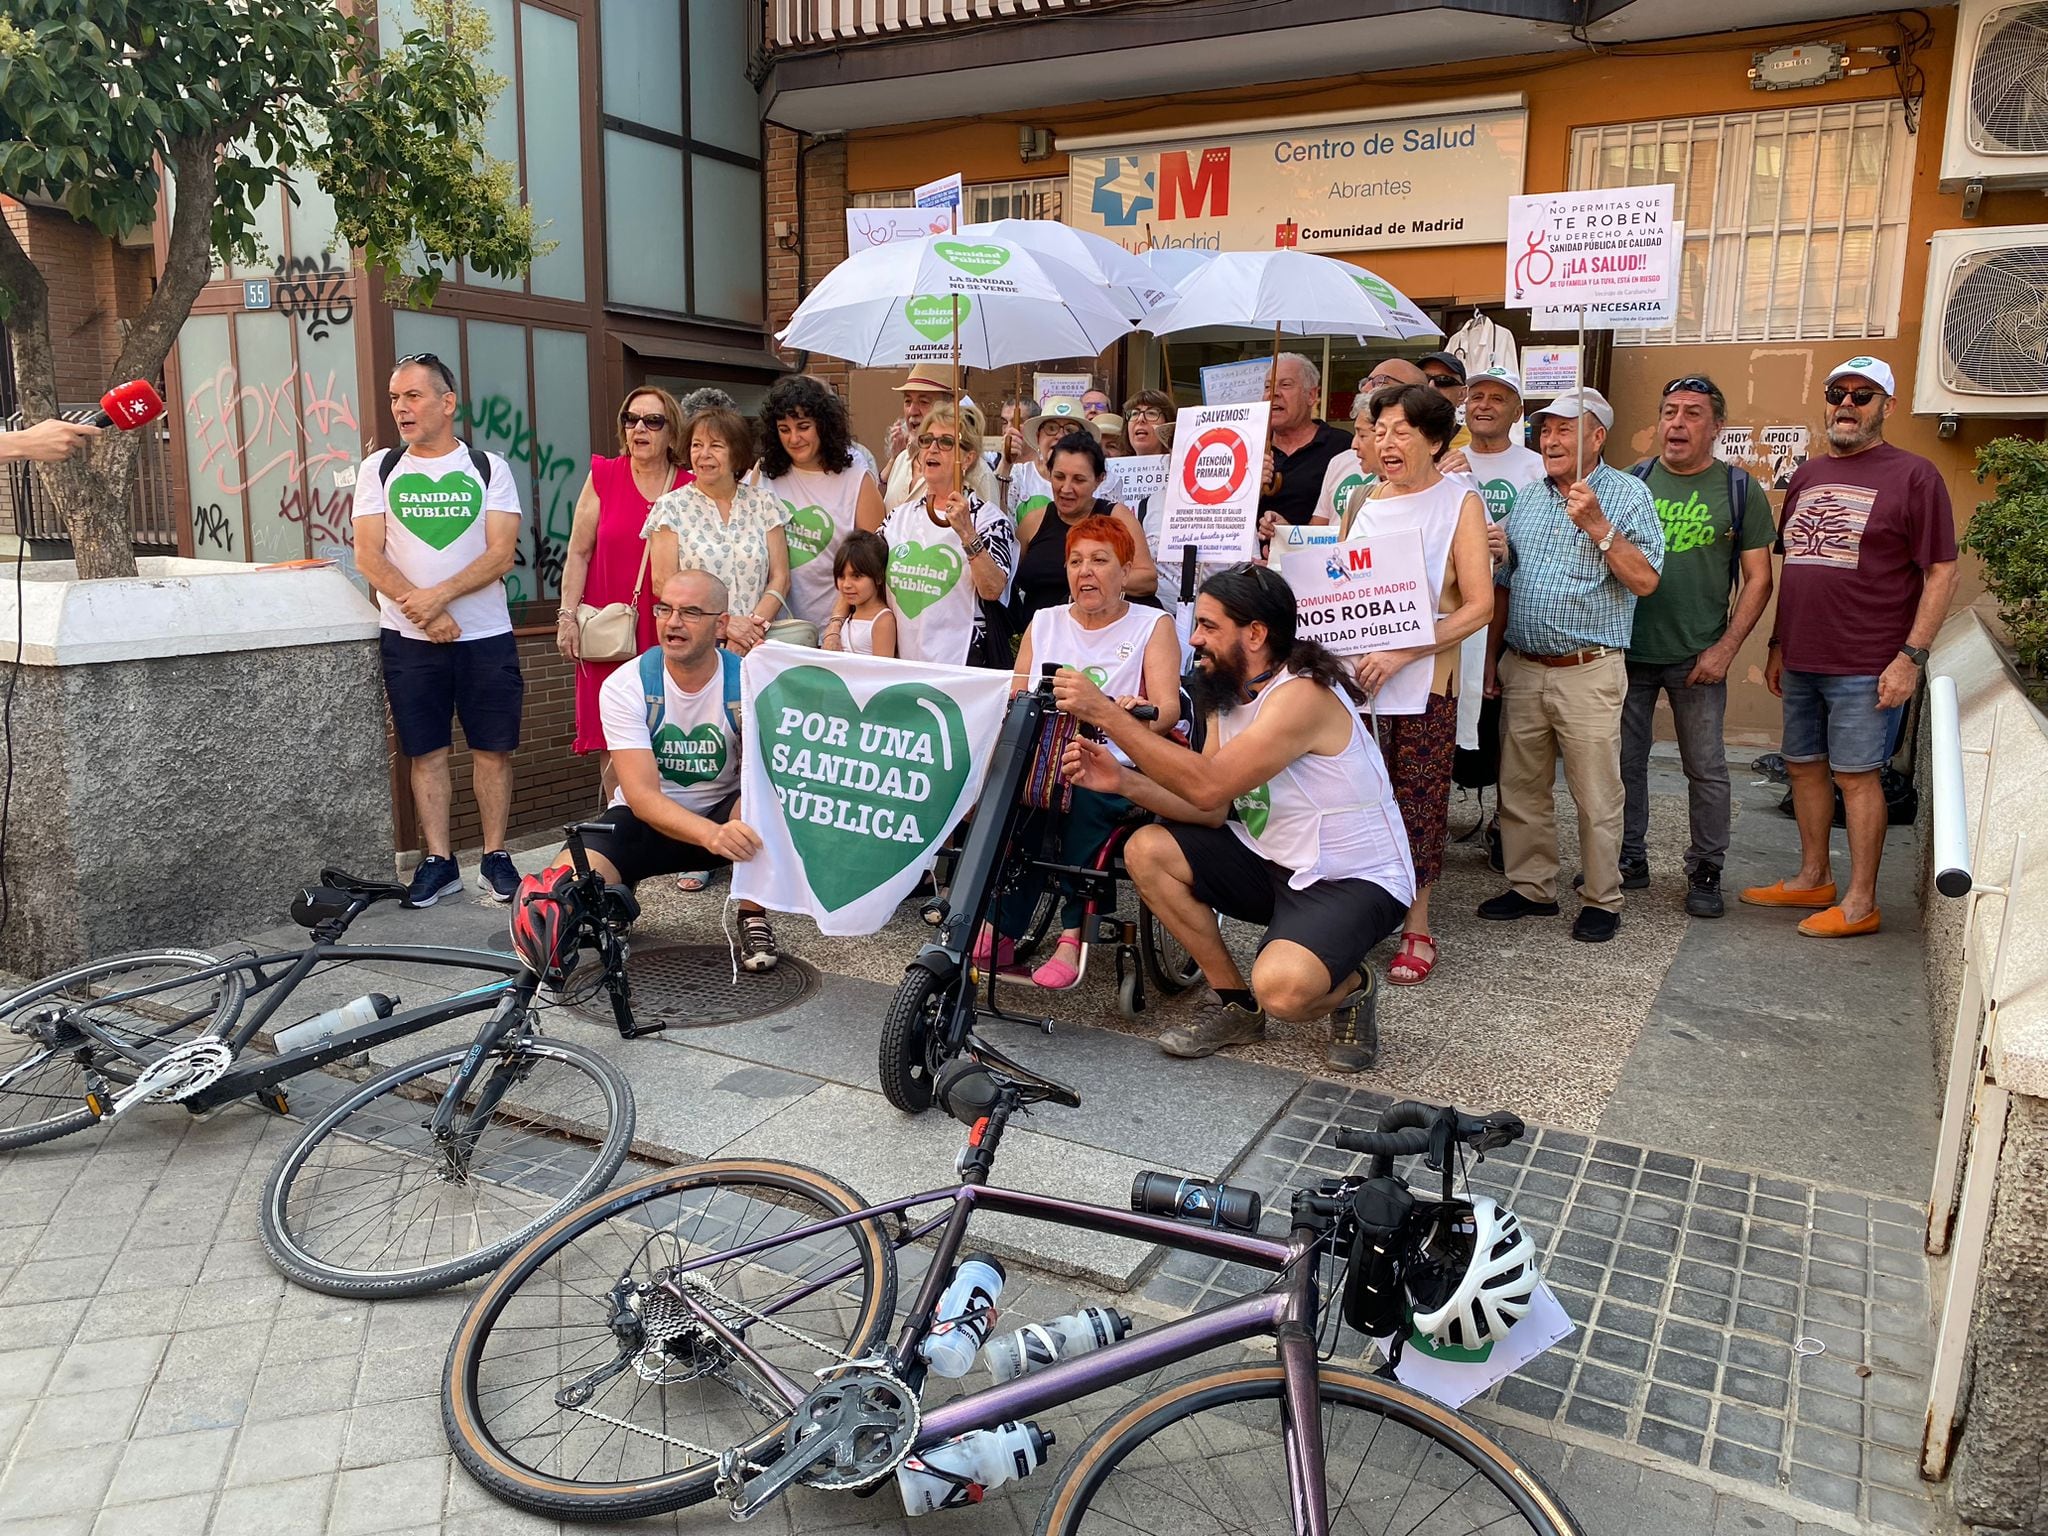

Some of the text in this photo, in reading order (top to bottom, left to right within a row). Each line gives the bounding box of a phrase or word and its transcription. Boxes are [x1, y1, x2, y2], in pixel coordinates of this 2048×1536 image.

[1275, 124, 1475, 164] Centro de Salud
[1158, 147, 1230, 220] M
[1328, 179, 1411, 199] Abrantes
[1550, 199, 1660, 214] NO PERMITAS QUE
[1301, 217, 1464, 240] Comunidad de Madrid
[1554, 212, 1657, 230] TE ROBEN
[1566, 230, 1621, 241] DERECHO
[1626, 229, 1634, 237] A
[1639, 227, 1664, 235] UNA
[1550, 237, 1662, 253] SANIDAD PÚBLICA DE CALIDAD
[945, 249, 1001, 259] Sanidad
[1591, 254, 1647, 273] SALUD!!
[965, 277, 1013, 286] SANIDAD
[982, 285, 1019, 293] VENDE
[1566, 279, 1587, 287] FAMILIA
[250, 285, 264, 303] 55
[1591, 302, 1661, 312] NECESARIA
[1195, 408, 1250, 427] ¡¡SALVEMOS!!
[1726, 446, 1745, 455] HAY
[1197, 453, 1232, 467] ATENCIÓN
[1196, 467, 1231, 478] PRIMARIA
[399, 492, 472, 503] SANIDAD
[401, 504, 472, 517] PÚBLICA
[1349, 547, 1372, 571] M
[890, 561, 948, 581] Sanidad
[890, 576, 941, 596] Pública
[1358, 588, 1371, 598] DE
[1373, 580, 1417, 595] MADRID
[1297, 600, 1416, 627] NOS ROBA LA
[1361, 620, 1421, 637] PÚBLICA
[776, 707, 935, 765] POR UNA
[661, 740, 717, 754] ANIDAD
[771, 743, 931, 802] SANIDAD
